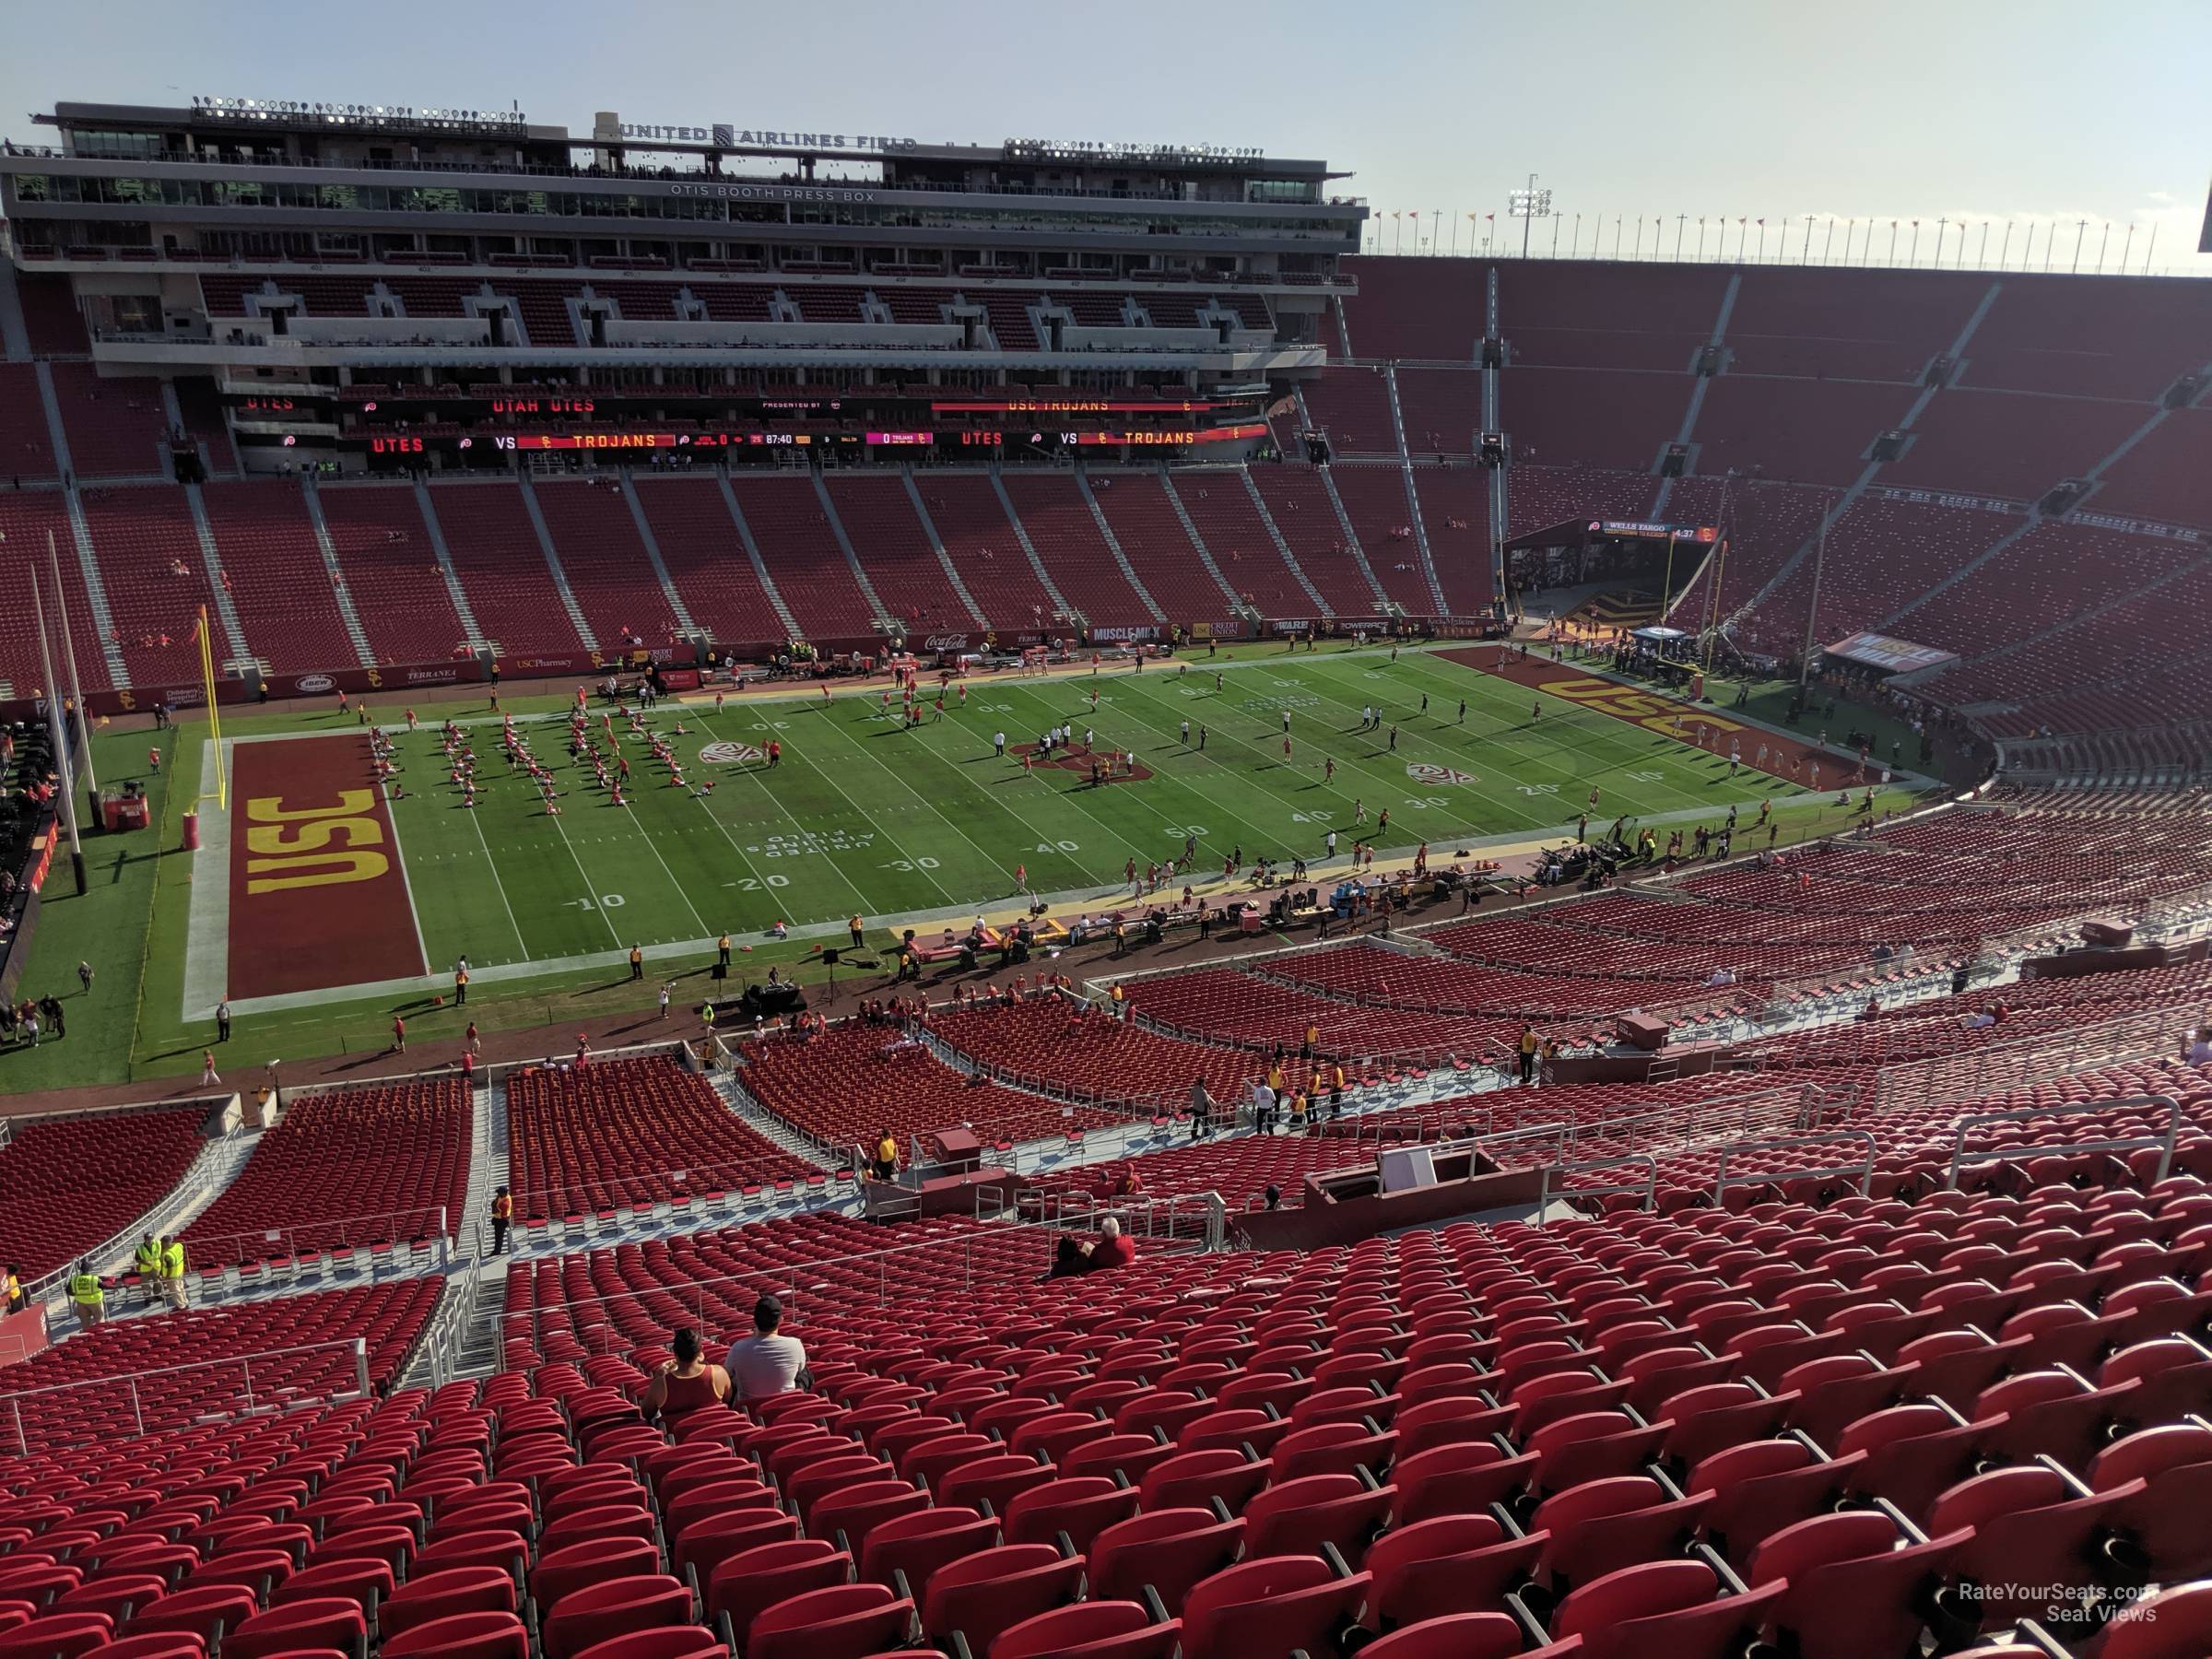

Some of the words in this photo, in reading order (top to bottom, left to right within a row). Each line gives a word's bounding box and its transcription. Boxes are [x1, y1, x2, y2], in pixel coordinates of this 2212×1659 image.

[620, 124, 708, 141] UNITED
[739, 130, 845, 148] AIRLINES
[857, 135, 917, 151] FIELD
[671, 185, 709, 196] OTIS
[717, 187, 775, 199] BOOTH
[783, 190, 834, 201] PRESS
[843, 192, 875, 203] BOX
[493, 399, 538, 413] UTAH
[552, 399, 594, 412] UTES
[1009, 400, 1037, 411] USC
[1043, 400, 1109, 411] TROJANS
[496, 437, 516, 450] VS
[573, 434, 656, 448] TROJANS
[766, 434, 793, 444] 87:40
[883, 433, 890, 444] 0
[962, 432, 1002, 445] UTES
[1061, 432, 1077, 445] VS
[1125, 432, 1194, 444] TROJANS
[372, 438, 424, 453] UTES
[1610, 521, 1637, 530] WELLS
[1639, 523, 1665, 532] FARGO
[1210, 621, 1240, 630] CREDIT
[1210, 628, 1239, 636] UNION
[1094, 628, 1135, 641] MUSCLE
[407, 670, 457, 680] TERRANEA
[1538, 678, 1746, 737] USC
[1626, 771, 1662, 783] 10
[1517, 783, 1559, 796] 20
[1405, 797, 1448, 809] 30
[1292, 809, 1329, 824] 40
[1163, 825, 1210, 840] 50
[246, 789, 389, 895] USC
[1036, 840, 1081, 854] 40
[890, 856, 941, 872] 30
[737, 875, 790, 891] 20
[577, 893, 626, 911] 10
